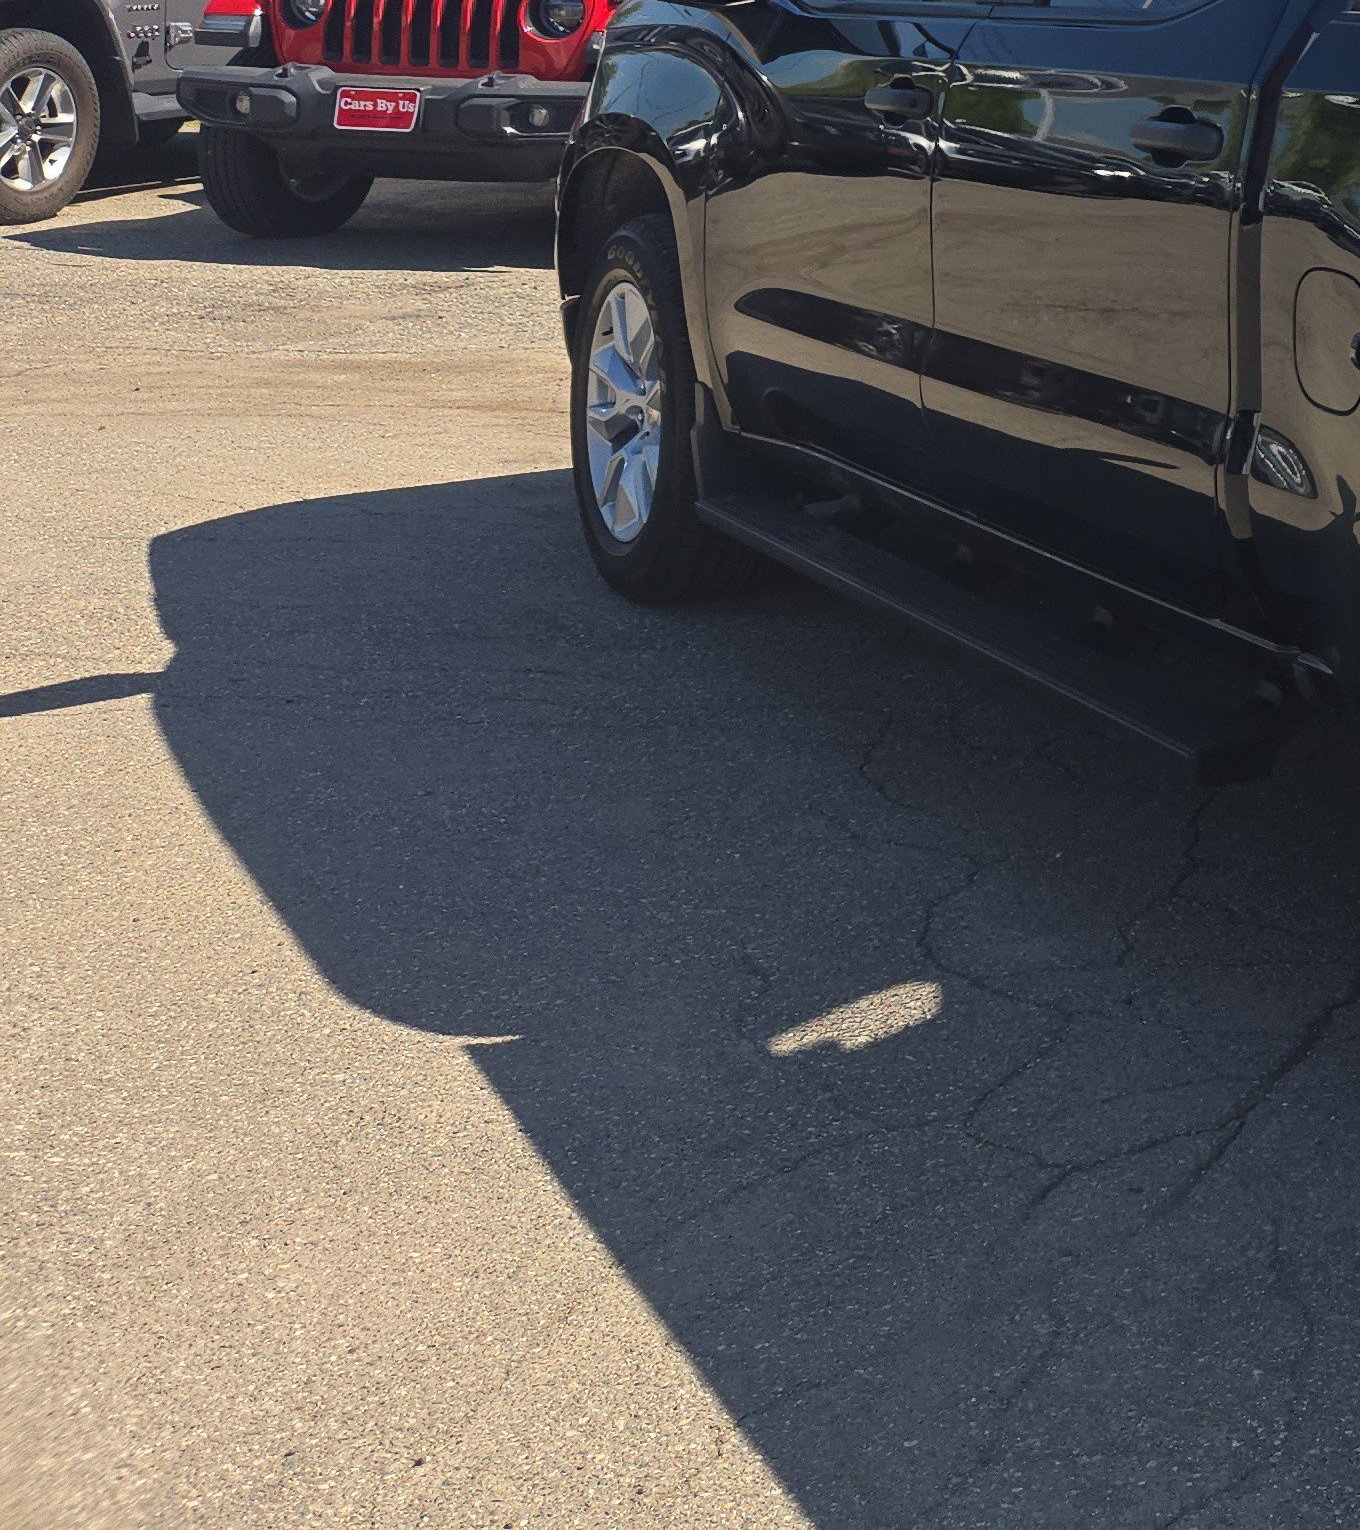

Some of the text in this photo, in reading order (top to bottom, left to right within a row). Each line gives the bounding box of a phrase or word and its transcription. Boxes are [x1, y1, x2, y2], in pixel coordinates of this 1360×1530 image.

[340, 97, 416, 114] Cars By Us
